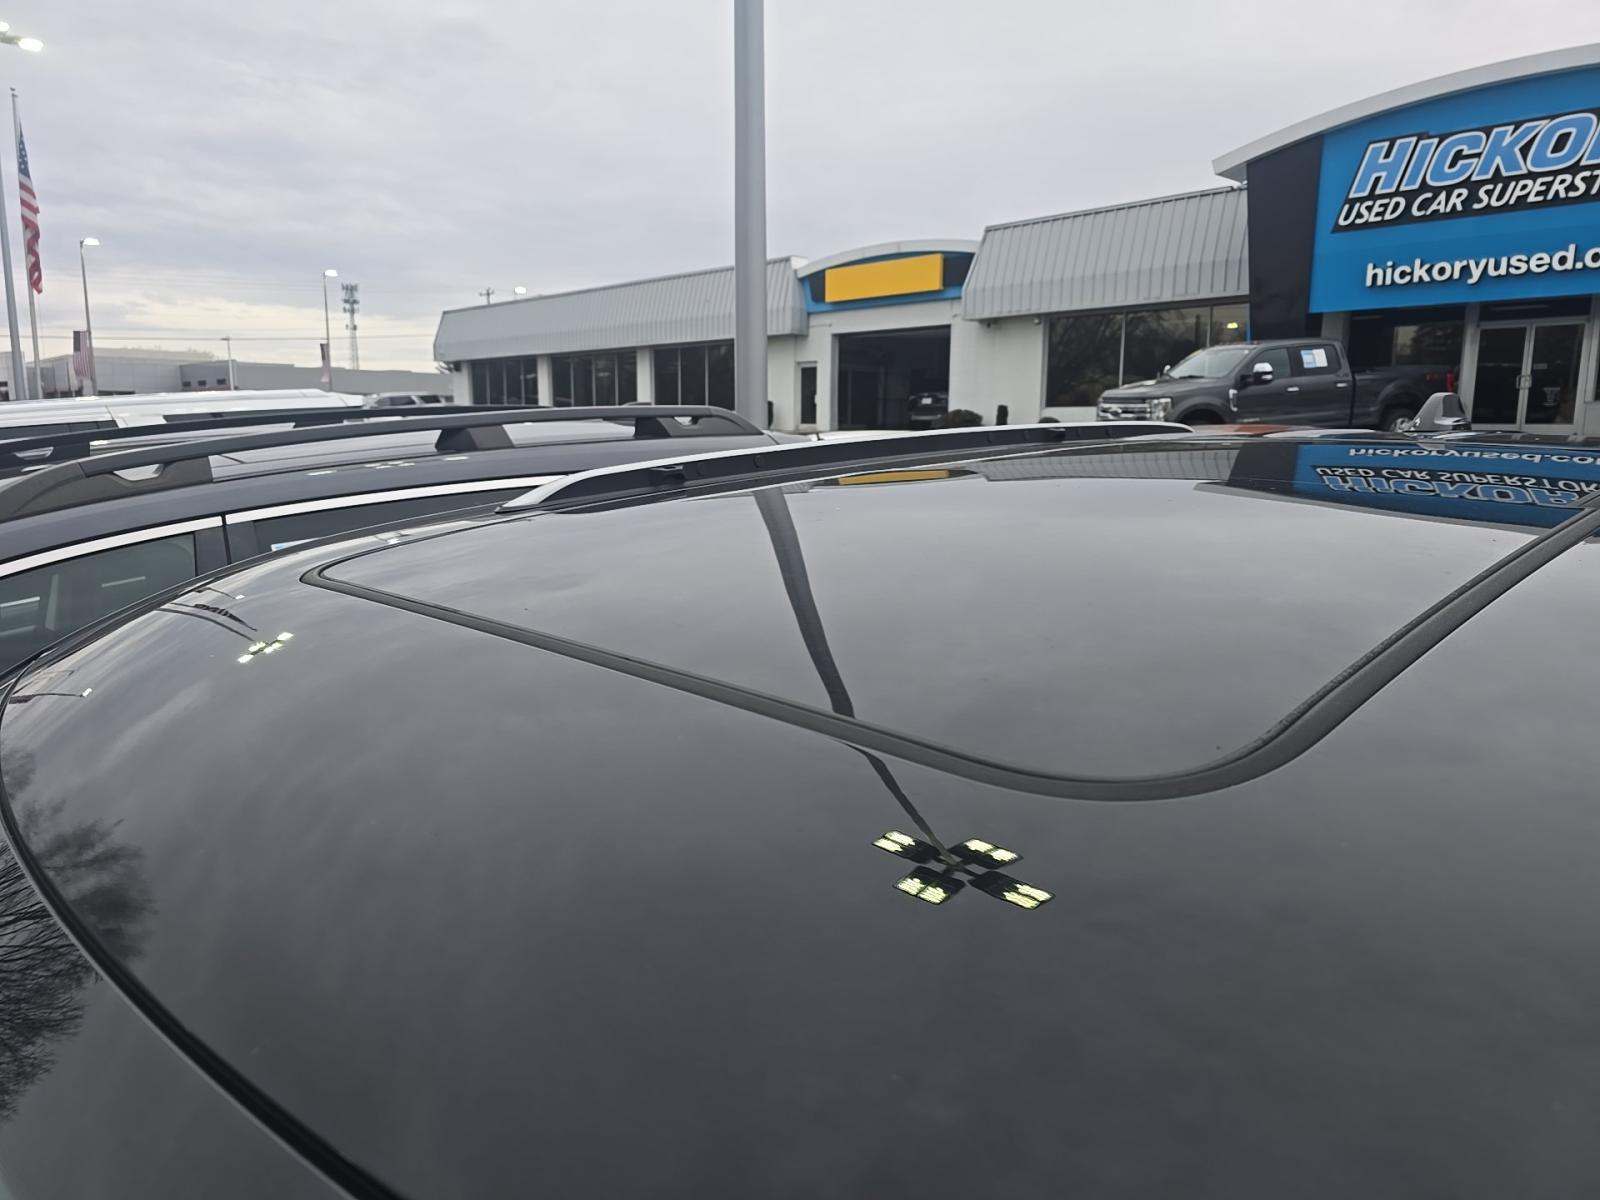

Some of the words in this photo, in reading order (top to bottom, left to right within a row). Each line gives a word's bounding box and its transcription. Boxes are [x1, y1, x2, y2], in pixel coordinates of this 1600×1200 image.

[1349, 112, 1600, 198] HICKO
[1338, 197, 1406, 226] USED
[1411, 188, 1468, 217] CAR
